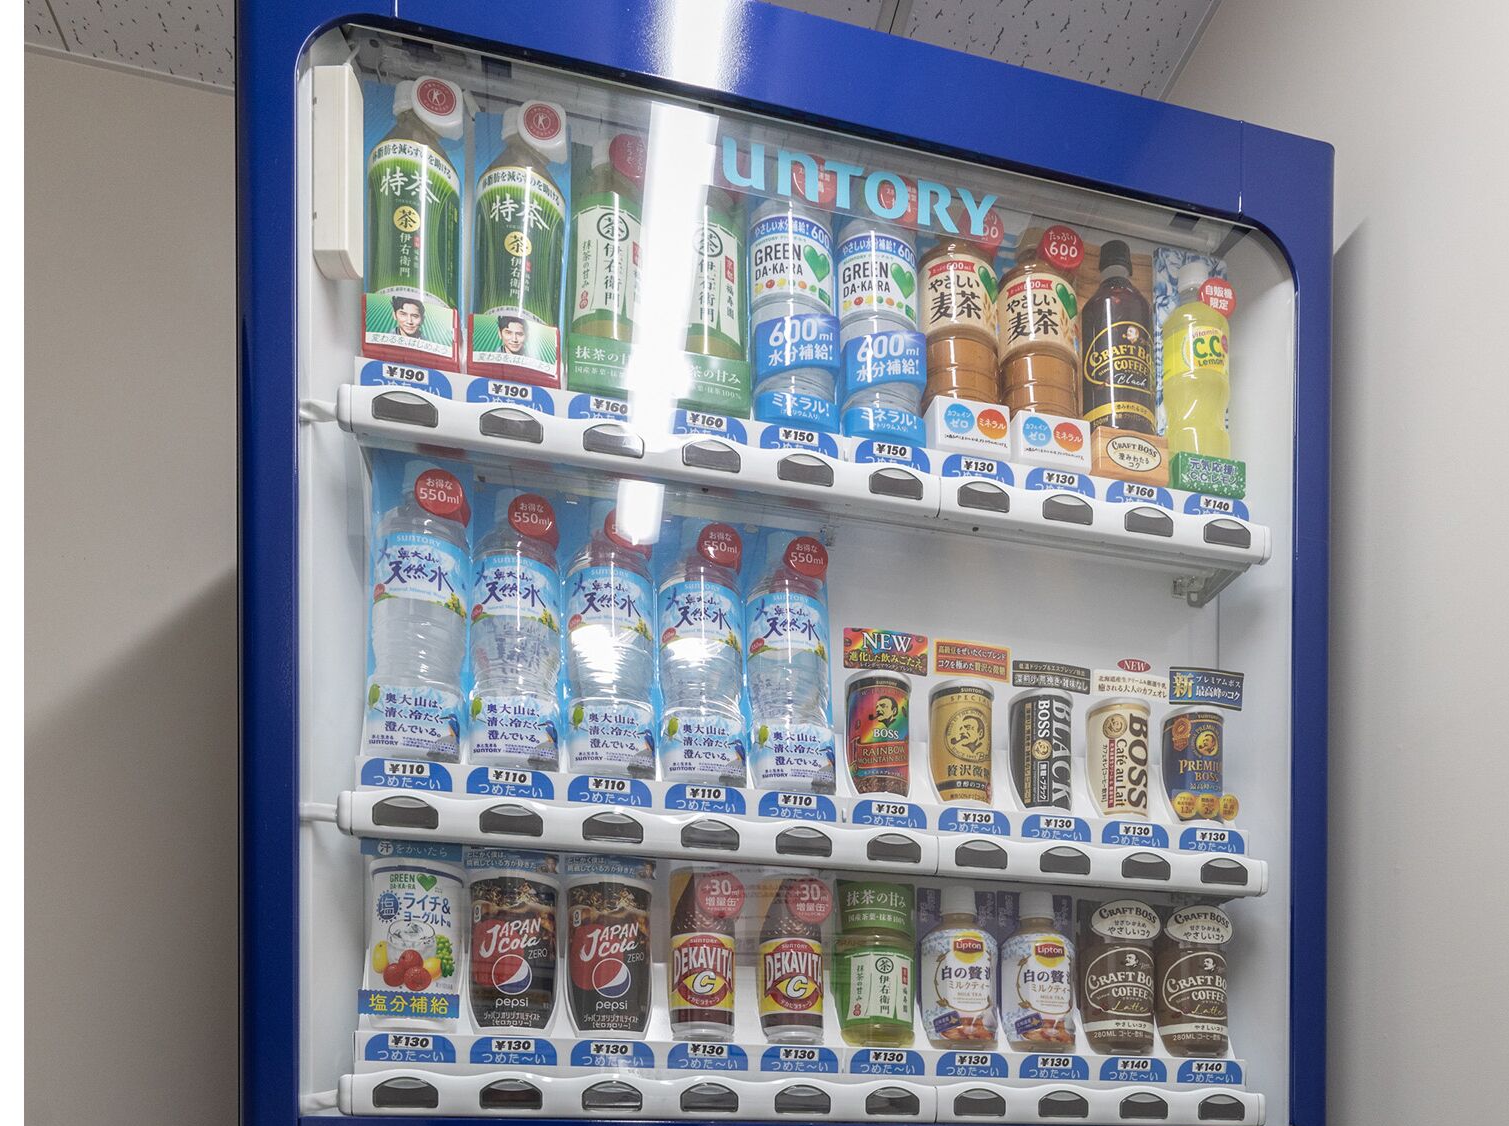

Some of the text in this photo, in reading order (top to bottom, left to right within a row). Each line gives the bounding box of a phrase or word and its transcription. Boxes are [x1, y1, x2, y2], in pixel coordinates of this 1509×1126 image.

[1205, 285, 1233, 298] 自販機
[931, 291, 982, 324] 麦茶
[1210, 298, 1229, 311] 限定
[387, 366, 425, 381] ¥190
[492, 383, 528, 397] ¥190
[950, 418, 968, 429] ゼロ
[782, 429, 814, 442] ¥150
[876, 443, 907, 457] ¥150
[426, 478, 453, 490] お得な
[420, 488, 460, 504] 550ml
[1126, 485, 1154, 498] ¥160
[520, 502, 544, 512] お得な
[1204, 499, 1230, 511] ¥140
[384, 561, 454, 592] 天然水
[863, 632, 911, 652] NEW
[849, 652, 923, 669] 進化した飲みごたえ
[1124, 661, 1147, 671] NEW
[1174, 673, 1193, 698] 新
[1197, 676, 1241, 688] プレミアムボス
[1196, 686, 1240, 700] 最高峰のコク
[873, 729, 899, 739] BOSS
[1128, 713, 1148, 809] BOSS
[389, 763, 425, 774] ¥110
[493, 770, 527, 783] ¥110
[390, 874, 415, 882] GREEN
[403, 893, 451, 914] ライチ&
[846, 891, 907, 909] 抹茶の甘み
[1099, 907, 1133, 919] CRAFT
[956, 942, 982, 950] Lipton
[1037, 947, 1063, 955] Lipton
[528, 948, 547, 959] ZERO
[673, 947, 733, 985] DEKAVITA
[693, 970, 716, 994] C
[370, 994, 449, 1014] 塩分補給
[495, 998, 529, 1008] pepsi
[392, 1036, 429, 1046] ¥130
[495, 1040, 530, 1050] ¥130
[1120, 1061, 1148, 1069] ¥140
